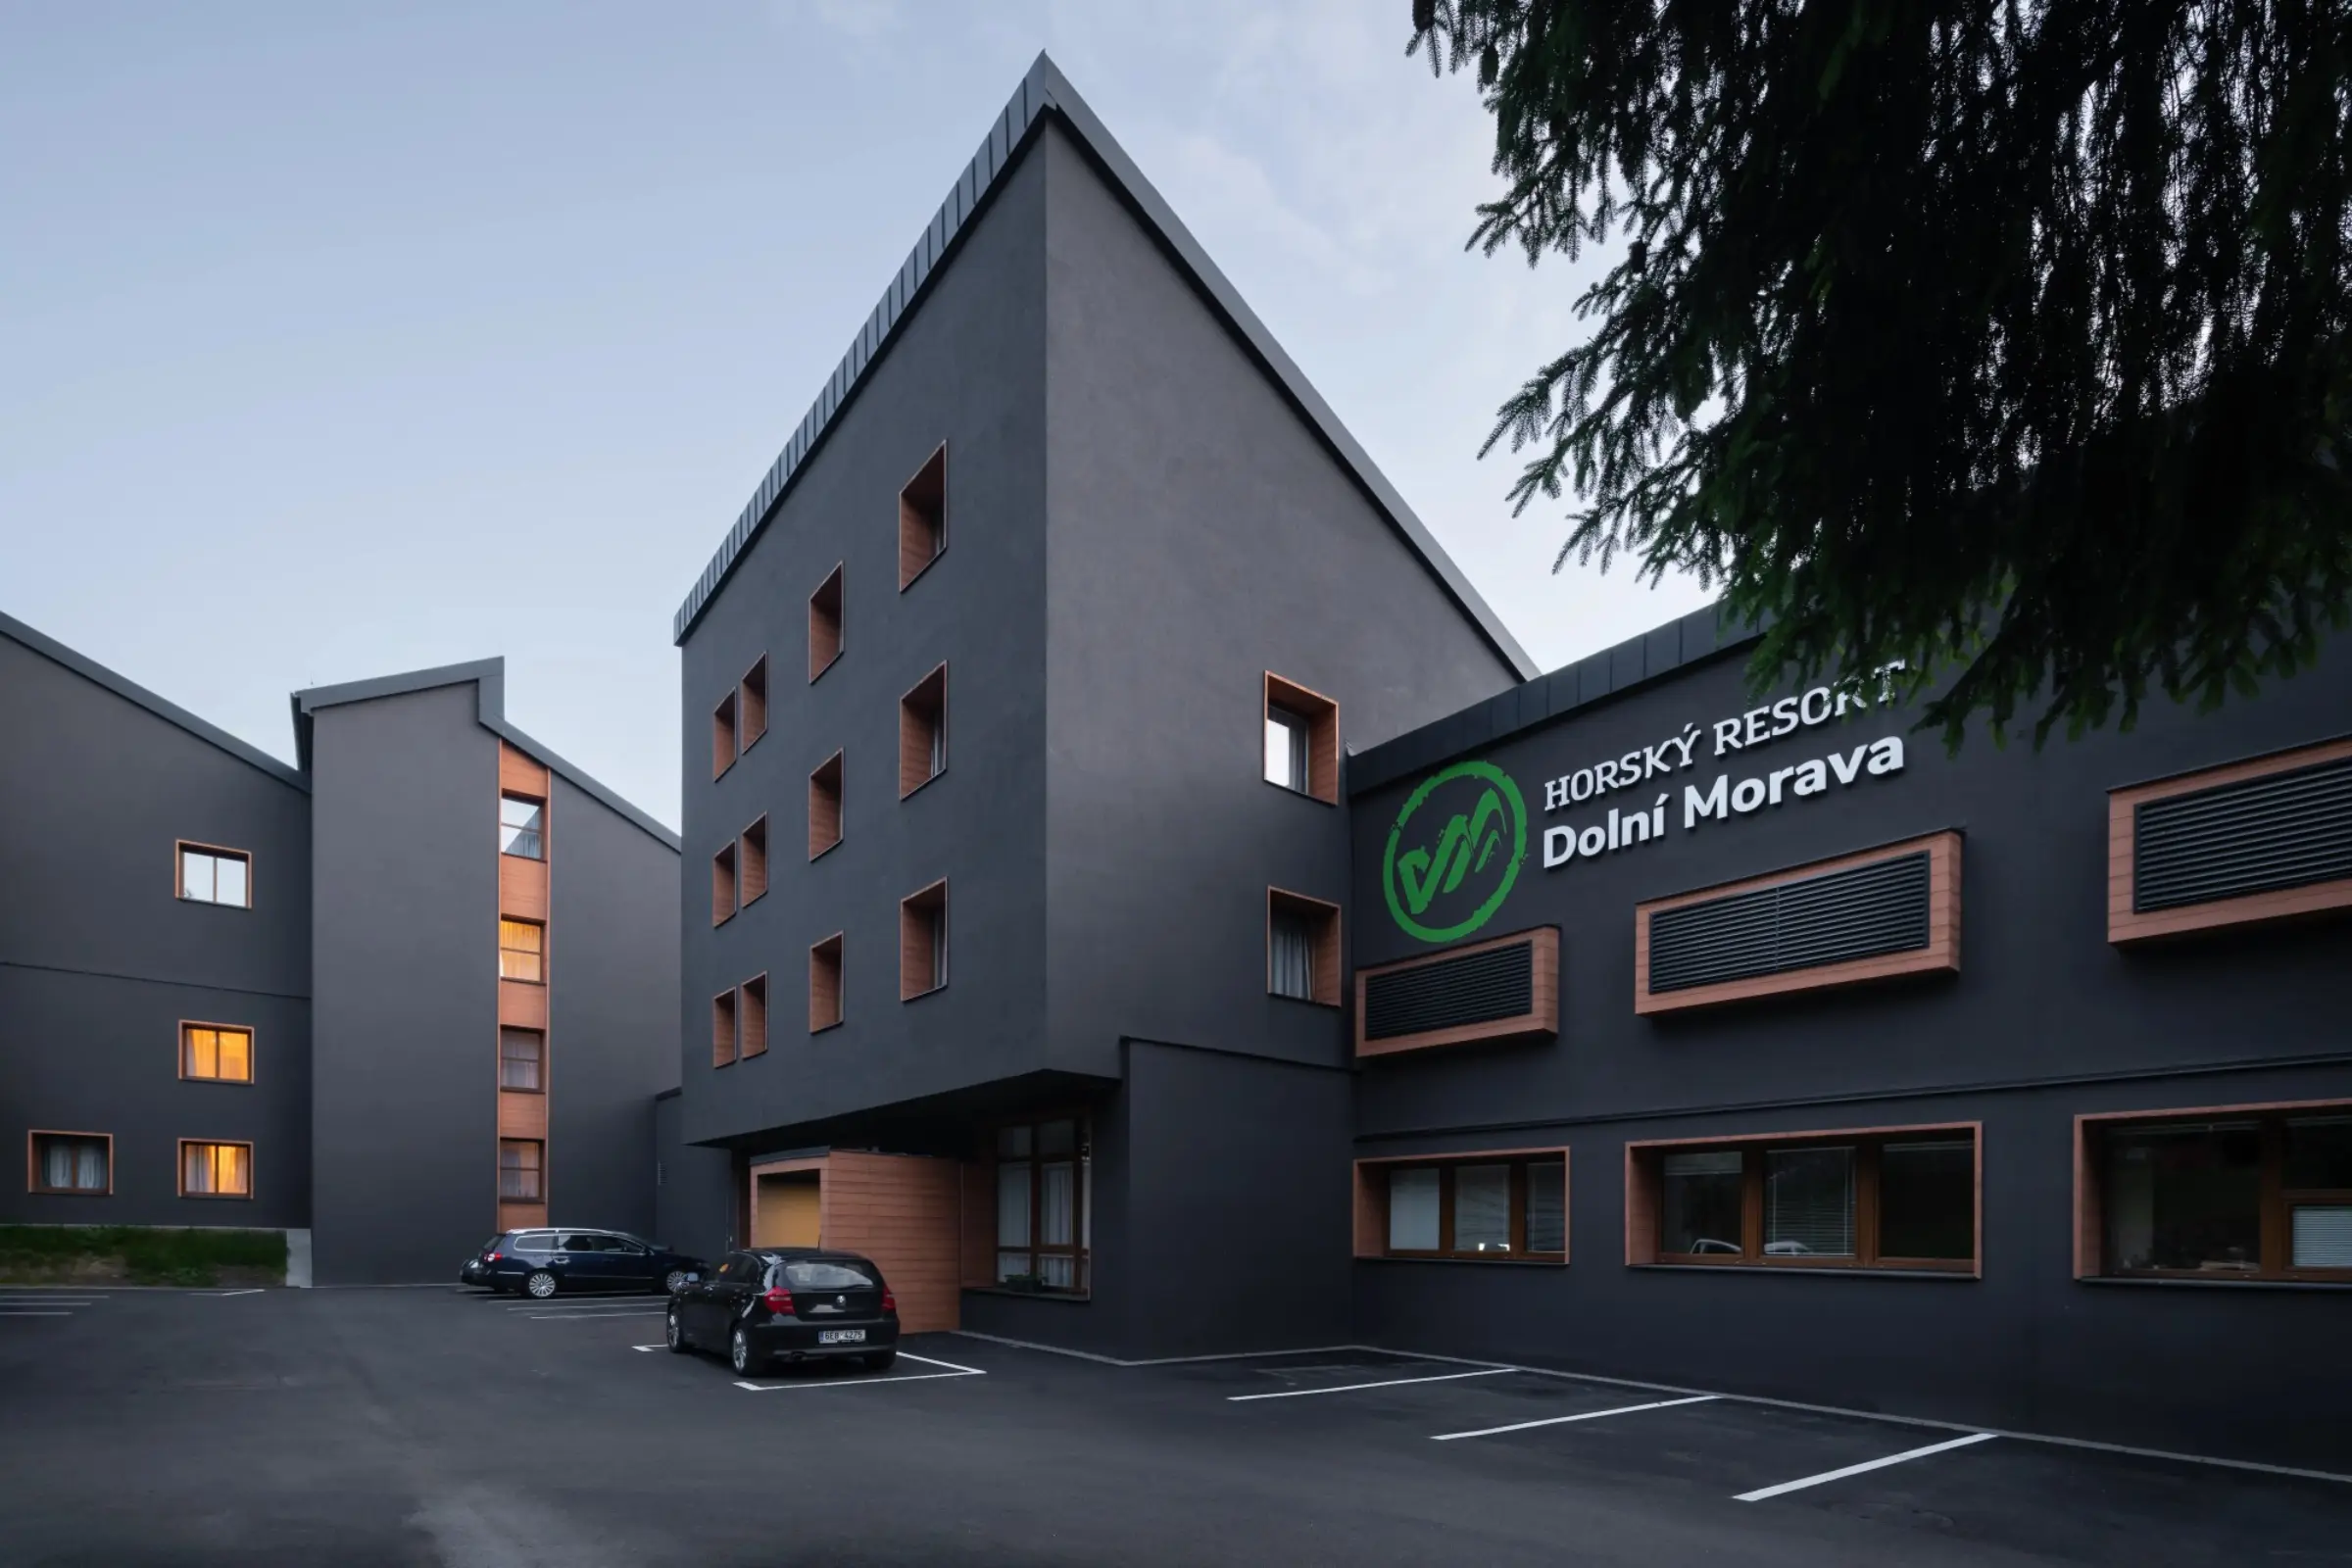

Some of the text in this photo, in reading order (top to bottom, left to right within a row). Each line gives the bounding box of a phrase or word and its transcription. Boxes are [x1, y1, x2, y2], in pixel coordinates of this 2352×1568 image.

[1544, 722, 1701, 811] HORSKÝ
[1544, 735, 1904, 868] Dolní Morava
